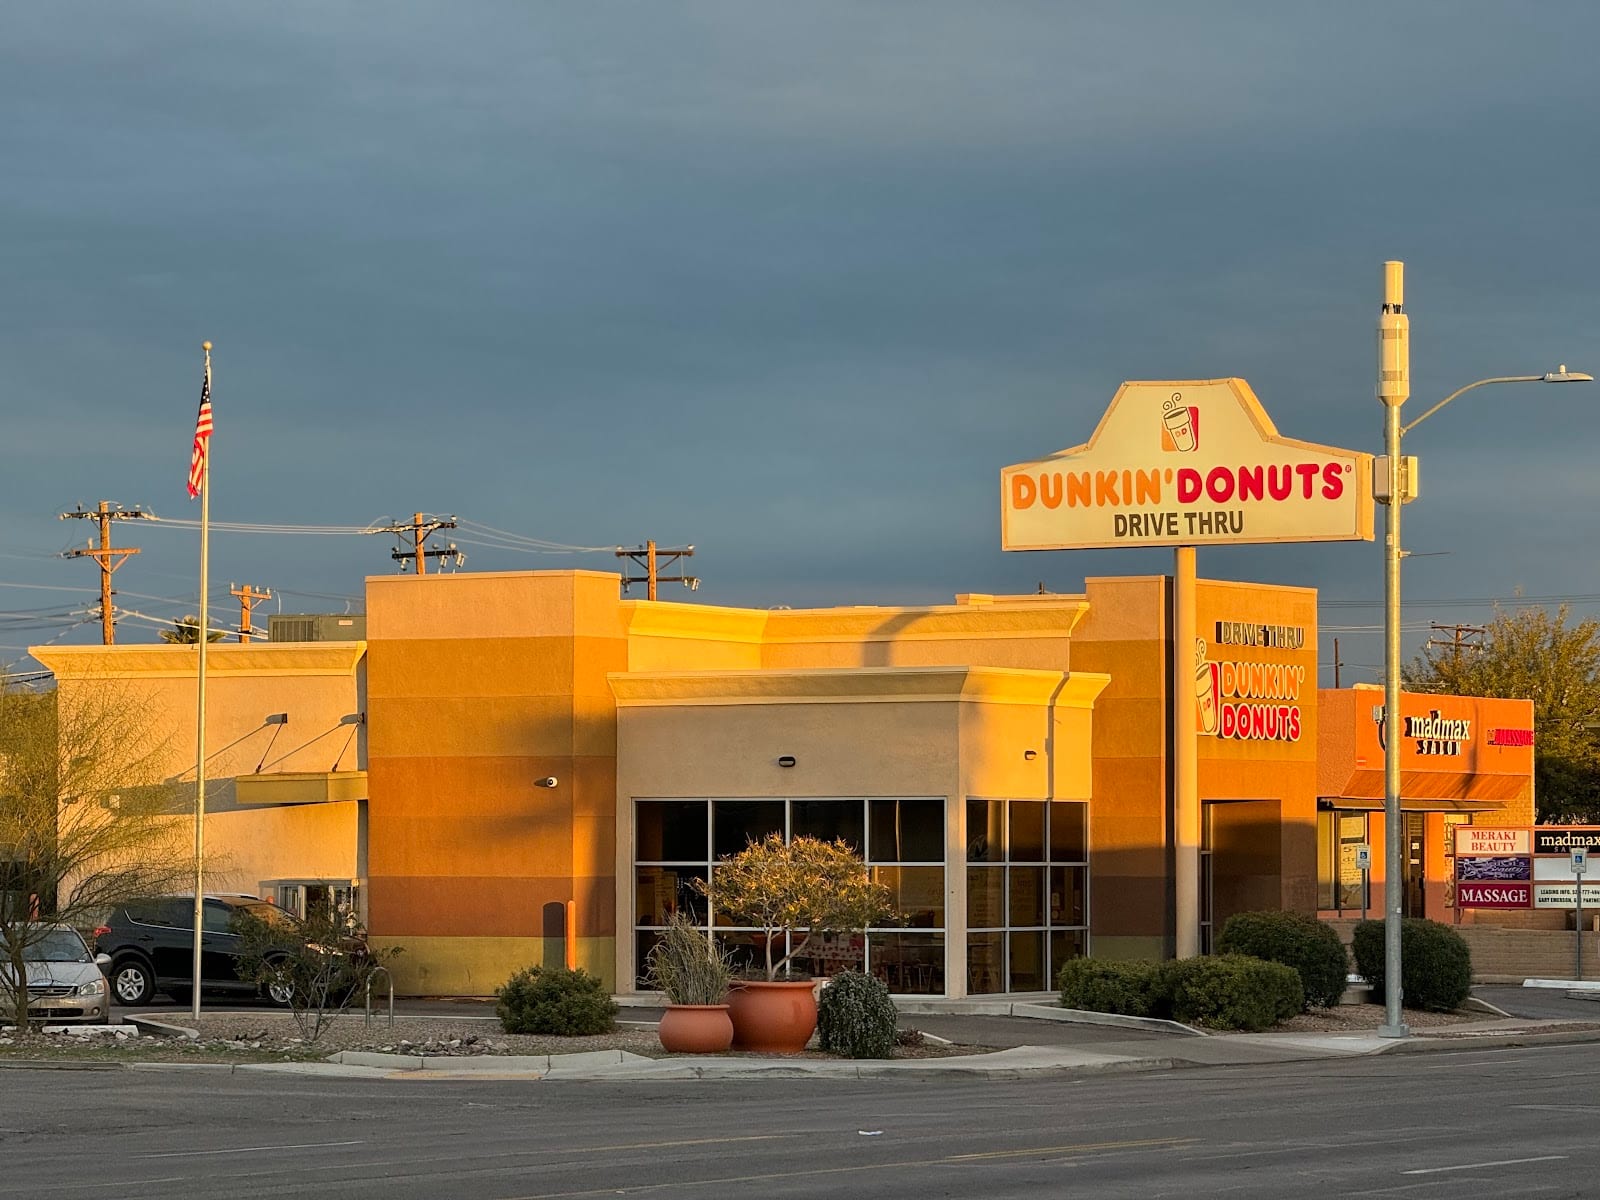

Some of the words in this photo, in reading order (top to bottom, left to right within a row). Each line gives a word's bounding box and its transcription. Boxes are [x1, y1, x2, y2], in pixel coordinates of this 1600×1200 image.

[1012, 468, 1173, 510] DUNKIN'
[1114, 513, 1179, 537] DRIVE
[1184, 510, 1244, 535] THRU
[1222, 621, 1264, 646] DRIVE
[1267, 625, 1305, 649] THRU
[1221, 661, 1305, 700] DUNKIN'
[1221, 703, 1302, 741] DONUTS
[1410, 710, 1471, 740] madmax
[1422, 740, 1461, 756] SALON
[1471, 831, 1516, 840] MERAKI
[1471, 842, 1516, 852] BEAUTY
[1540, 832, 1600, 846] madmax
[1461, 889, 1528, 903] MASSAGE
